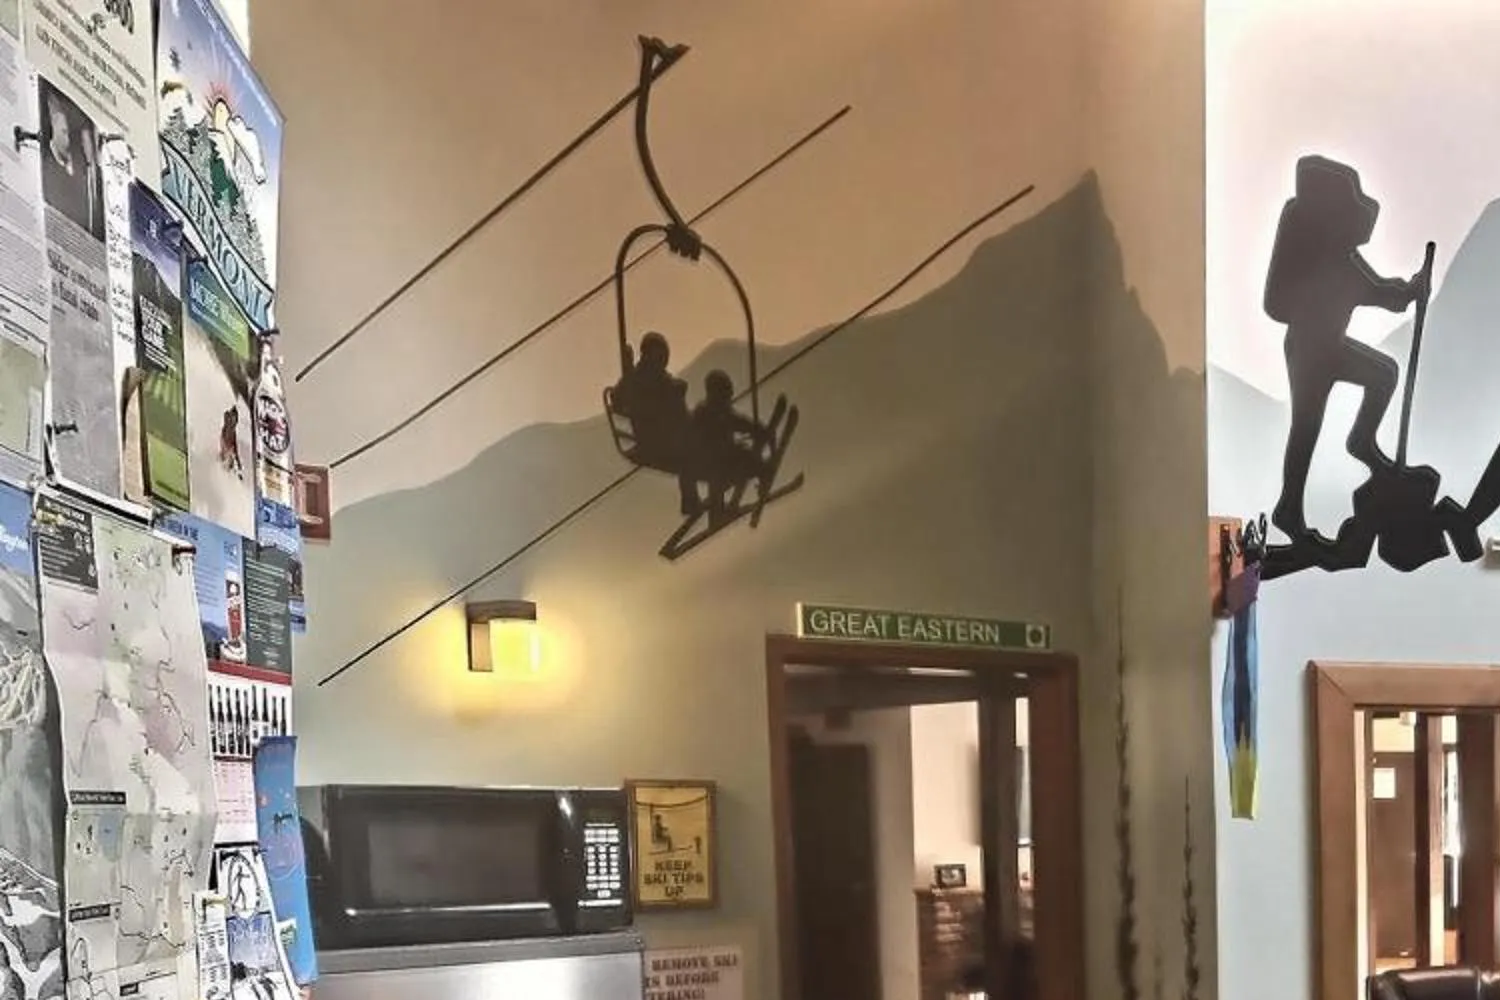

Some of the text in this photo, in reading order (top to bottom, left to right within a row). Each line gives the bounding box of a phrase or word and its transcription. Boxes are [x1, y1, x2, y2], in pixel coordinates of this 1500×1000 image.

[171, 160, 263, 317] VERMONT
[809, 609, 1000, 644] GREAT EASTERN
[654, 859, 692, 871] KEEP
[643, 871, 704, 885] SKI TIPS
[664, 885, 684, 898] UP
[651, 952, 738, 972] REMOVE SKI
[665, 971, 720, 987] BEFORE
